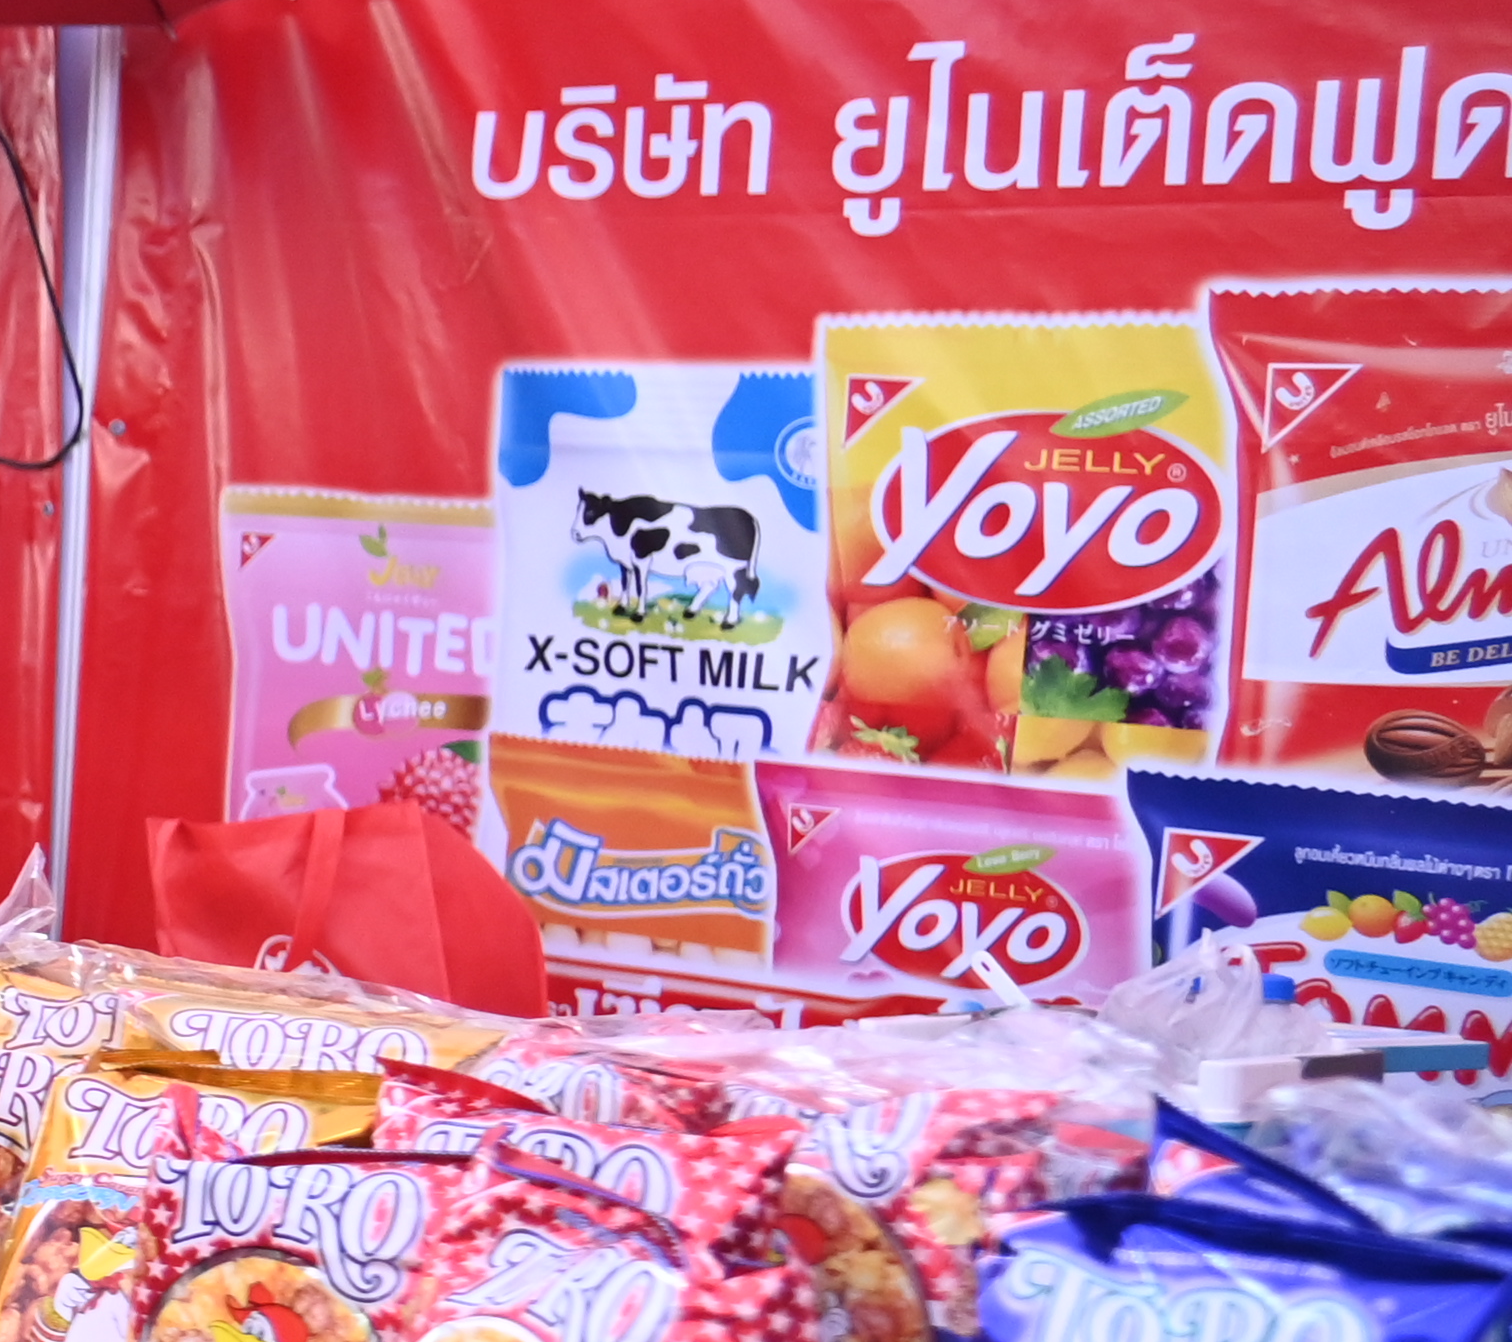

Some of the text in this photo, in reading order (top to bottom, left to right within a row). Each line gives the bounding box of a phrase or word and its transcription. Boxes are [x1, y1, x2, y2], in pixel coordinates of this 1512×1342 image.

[471, 73, 772, 200] บริษัท
[1072, 395, 1163, 430] ASSORTED
[1024, 448, 1166, 476] JELLY
[861, 425, 1200, 597] Yoyo
[1031, 621, 1135, 645] グミゼリー
[525, 635, 819, 693] X-SOFT MILK
[1430, 650, 1461, 668] BE
[950, 878, 1044, 903] JELLY
[839, 854, 1068, 980] Yoyo
[154, 1155, 422, 1304] TORO
